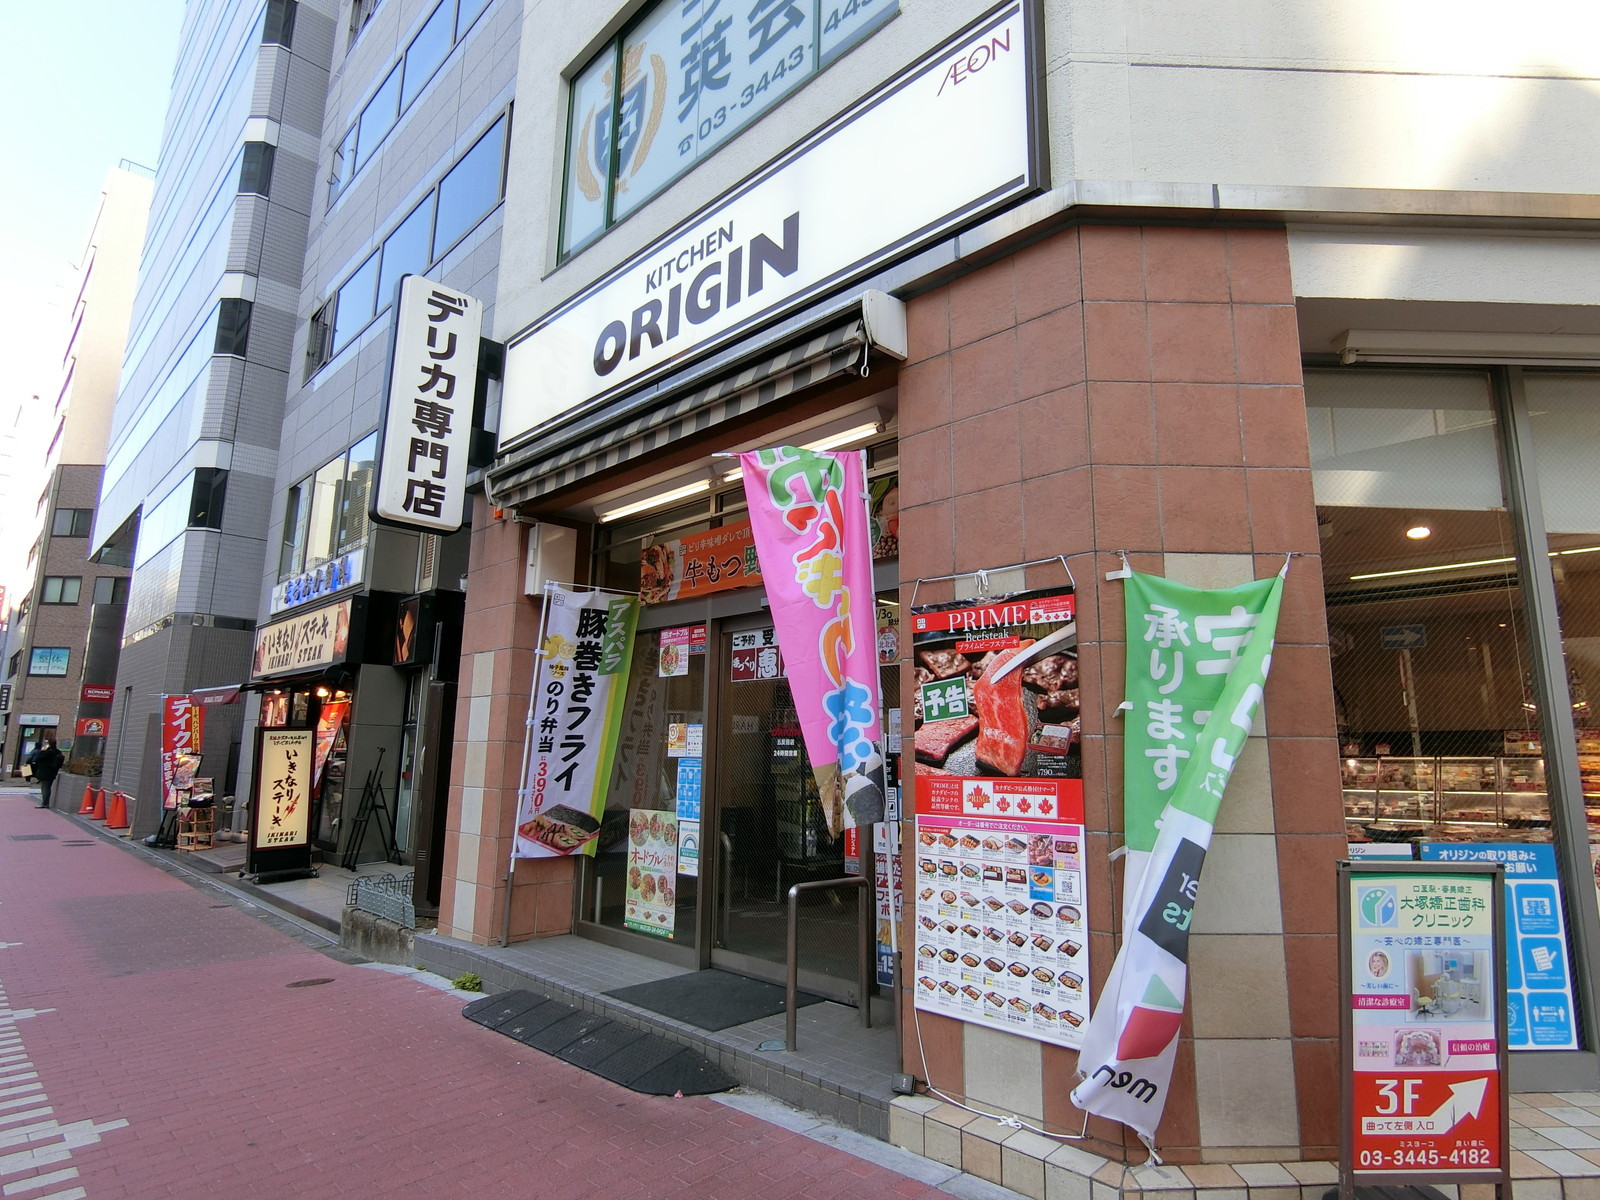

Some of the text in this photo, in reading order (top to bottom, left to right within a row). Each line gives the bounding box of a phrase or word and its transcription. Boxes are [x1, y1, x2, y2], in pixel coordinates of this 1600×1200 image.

[698, 0, 876, 141] 03-3443-44
[646, 220, 733, 294] KITCHEN
[594, 211, 799, 377] ORIGIN
[402, 290, 468, 518] デリカ専門店
[948, 605, 1027, 633] PRIME
[267, 614, 329, 656] いきなり ステーキ
[605, 602, 631, 672] アスパラ
[734, 634, 755, 646] ご予約
[965, 630, 1010, 643] Beefsteak
[267, 644, 323, 671] IKINARI STEAK
[554, 608, 610, 792] 豚巻きフライ
[925, 685, 966, 718] 予告
[538, 680, 564, 753] のり弁当
[285, 749, 298, 801] いきなり
[272, 779, 285, 827] ステーキ
[967, 795, 990, 803] PRIME
[267, 830, 298, 838] IKINARI
[267, 836, 295, 844] STEAK
[630, 847, 663, 867] オードブル
[1439, 849, 1537, 861] オリジンの取り組みと
[1504, 862, 1538, 873] お願い
[1400, 896, 1486, 912] 大塚矯正歯科
[1412, 913, 1474, 928] クリニック
[1375, 1079, 1423, 1114] 3F
[1366, 1121, 1435, 1131] 曲って左側 入口
[1360, 1148, 1490, 1166] 03-3445-4182
